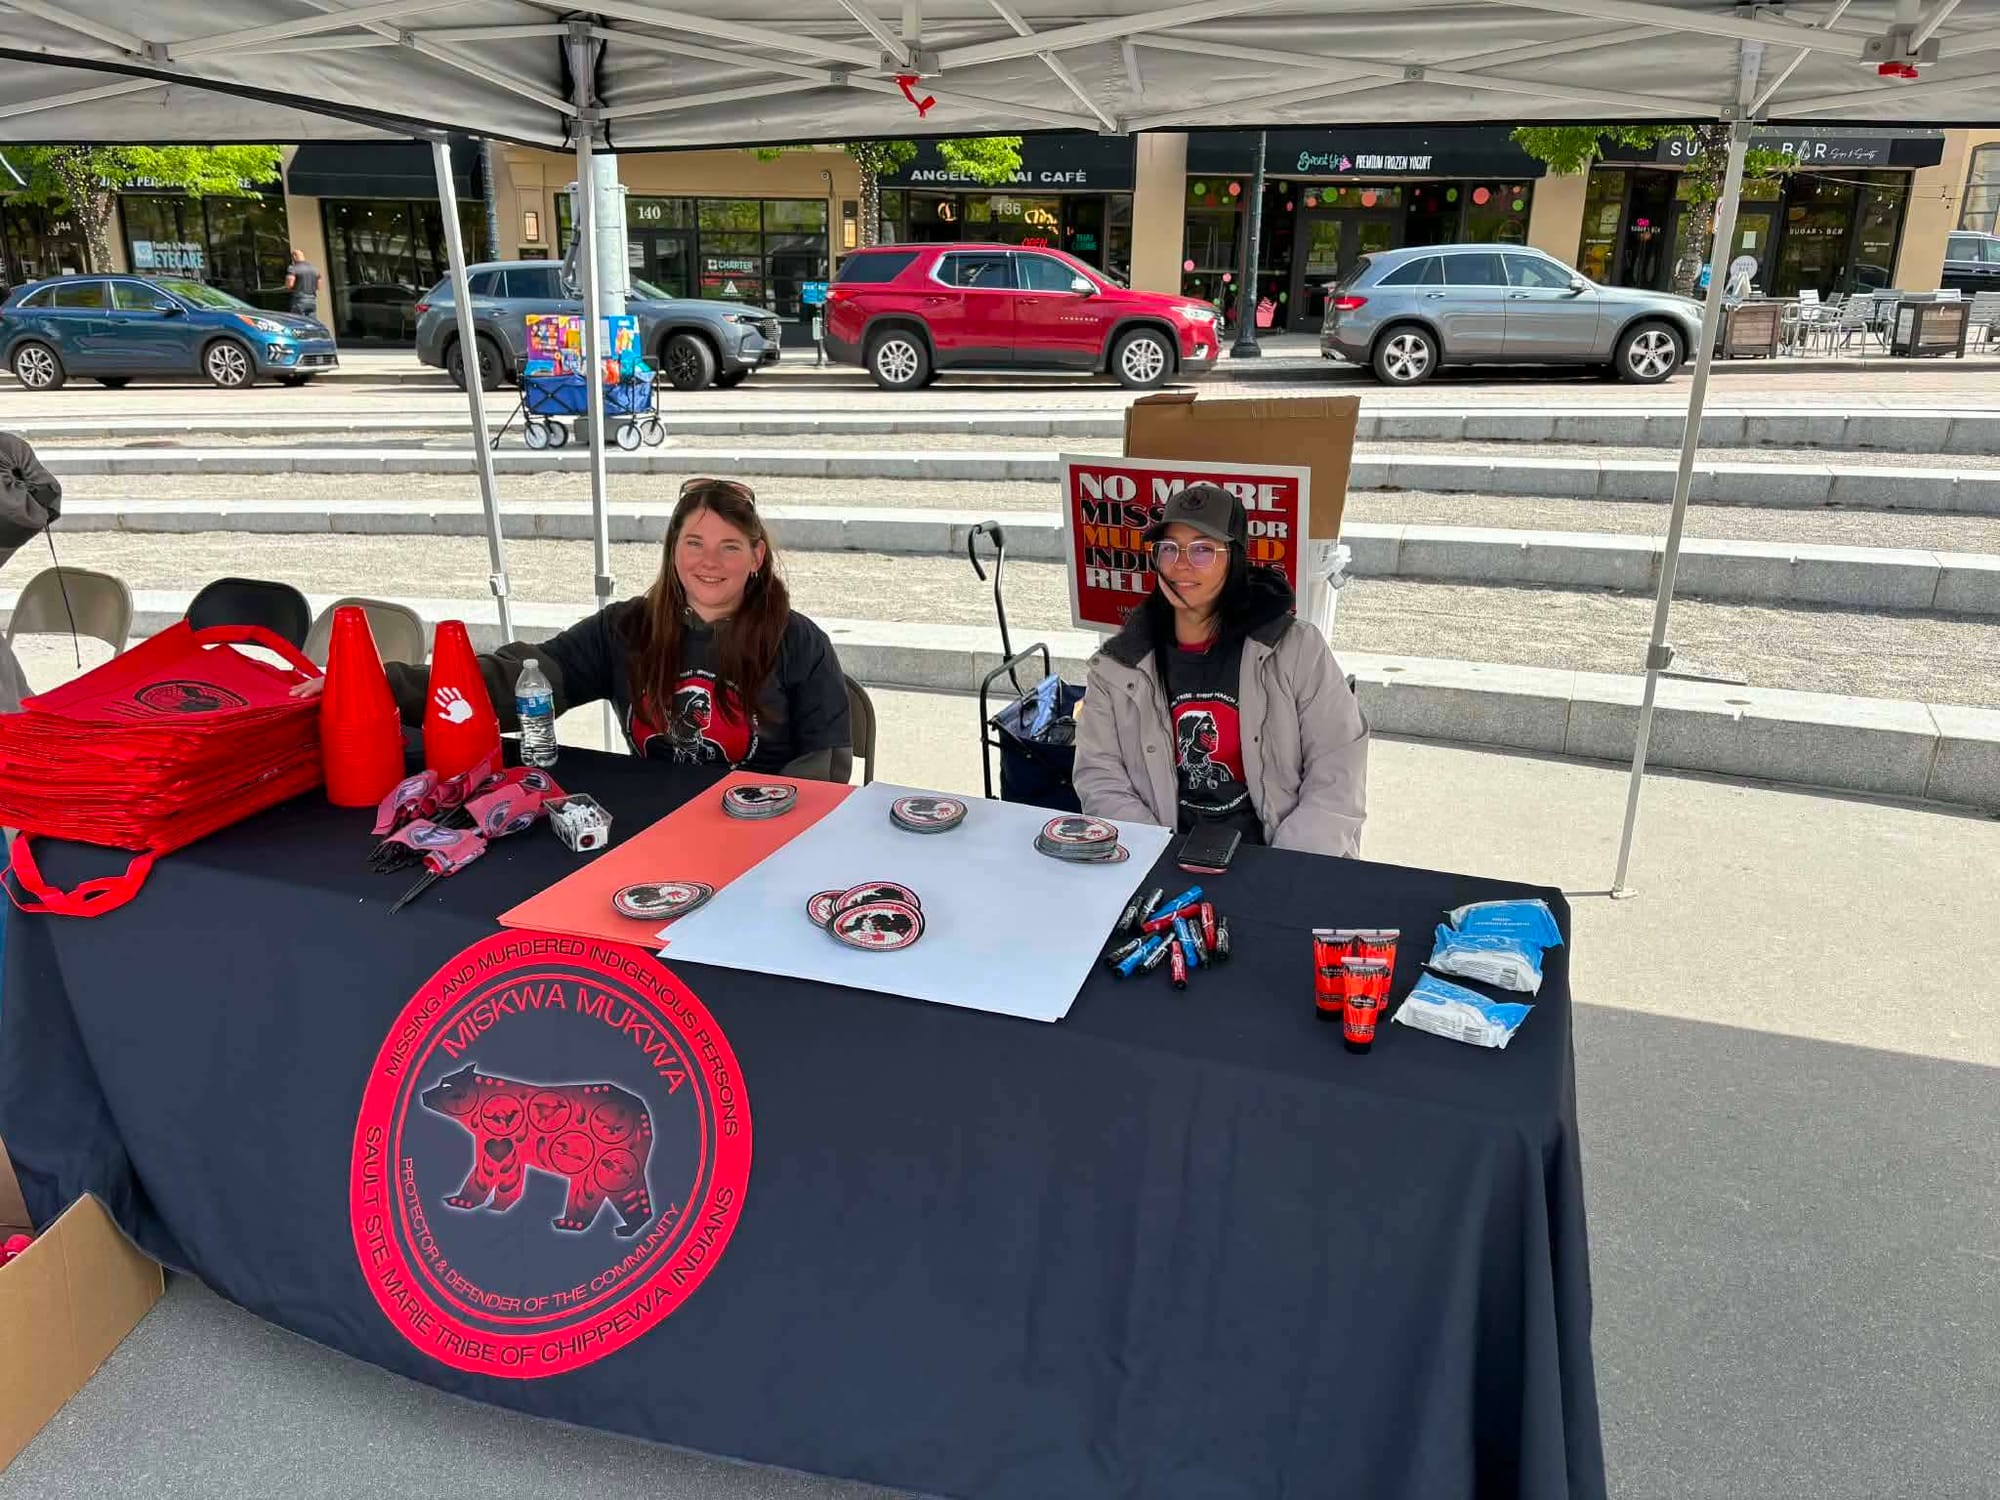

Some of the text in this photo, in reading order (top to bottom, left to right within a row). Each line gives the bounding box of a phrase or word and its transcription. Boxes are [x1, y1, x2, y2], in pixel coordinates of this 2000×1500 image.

[1383, 155, 1408, 170] FROZEN
[1040, 168, 1087, 183] CAFÉ
[637, 205, 661, 220] 140
[998, 202, 1022, 216] 136
[153, 251, 205, 269] EYECARE
[1079, 472, 1138, 502] NO
[1247, 520, 1288, 539] OR
[385, 938, 740, 1138] MISSING AND MURDERED INDIGENOUS PERSONS
[441, 982, 688, 1096] MISKWA MUKWA
[400, 1156, 679, 1312] PROTECTOR & DEFENDER OF THE COMMUNITY
[357, 1125, 735, 1366] SAULT STE. MARIE TRIBE OF CHIPPEWA INDIANS
